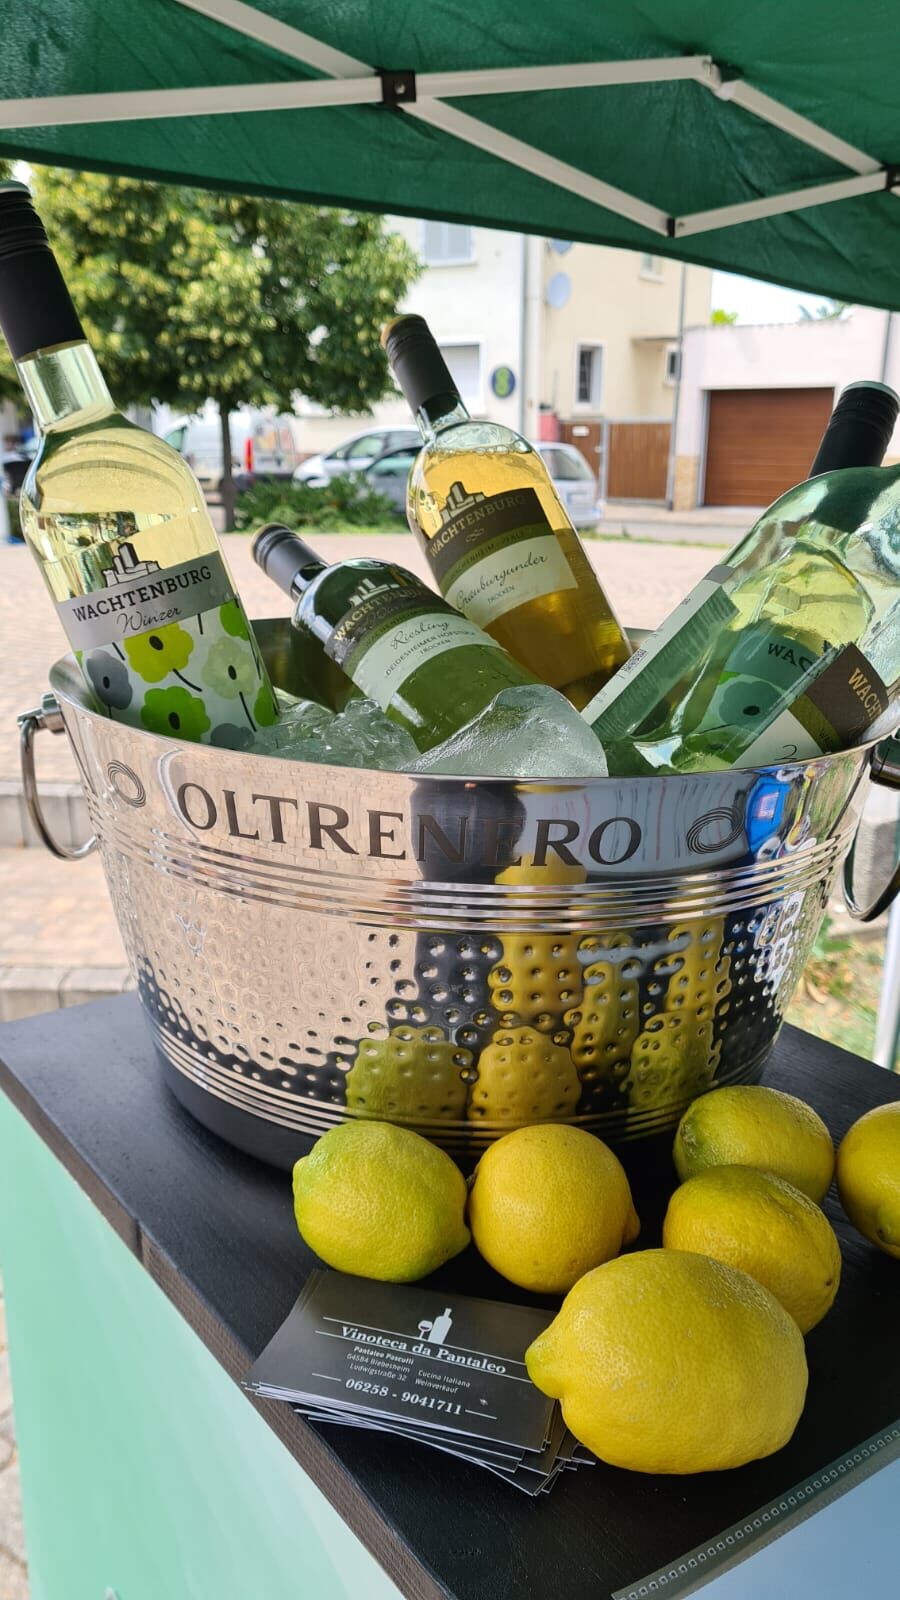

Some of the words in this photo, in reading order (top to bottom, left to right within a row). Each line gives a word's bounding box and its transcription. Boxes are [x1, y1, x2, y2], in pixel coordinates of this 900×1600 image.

[72, 565, 212, 622] WACHTENBURG
[116, 606, 183, 633] Winzer
[391, 620, 450, 650] Riesling
[176, 782, 642, 867] OLTRENERO
[341, 1326, 407, 1351] Vinoteca
[411, 1343, 431, 1357] da
[436, 1348, 507, 1375] Pantaleo
[353, 1346, 385, 1359] Pantaleo
[415, 1377, 459, 1394] Weinverkauf
[418, 1369, 442, 1382] Cucina
[443, 1374, 471, 1389] Italiana
[345, 1378, 389, 1397] 06258
[401, 1391, 462, 1416] 9041711
